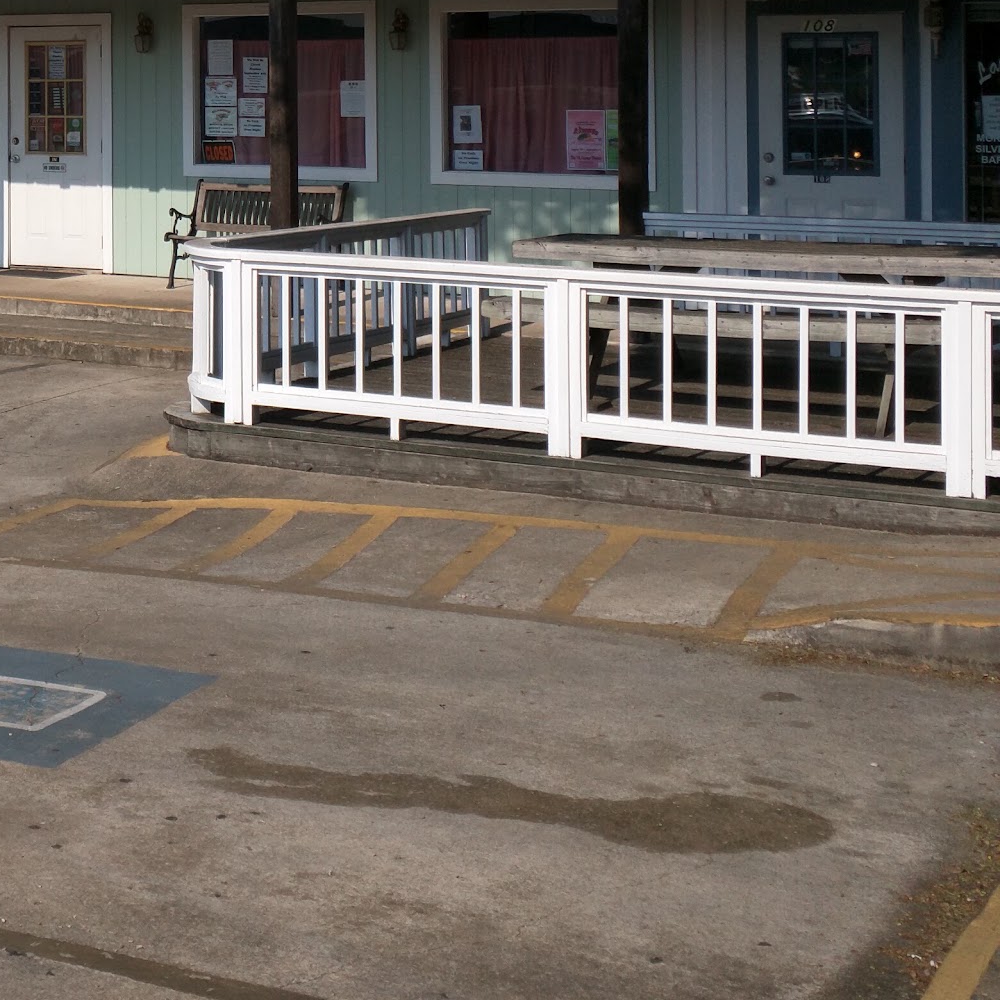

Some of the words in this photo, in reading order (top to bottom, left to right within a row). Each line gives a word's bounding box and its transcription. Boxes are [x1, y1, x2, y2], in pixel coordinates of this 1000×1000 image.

[804, 19, 835, 32] 108
[205, 145, 233, 161] CLOSED
[975, 144, 1000, 154] SILV
